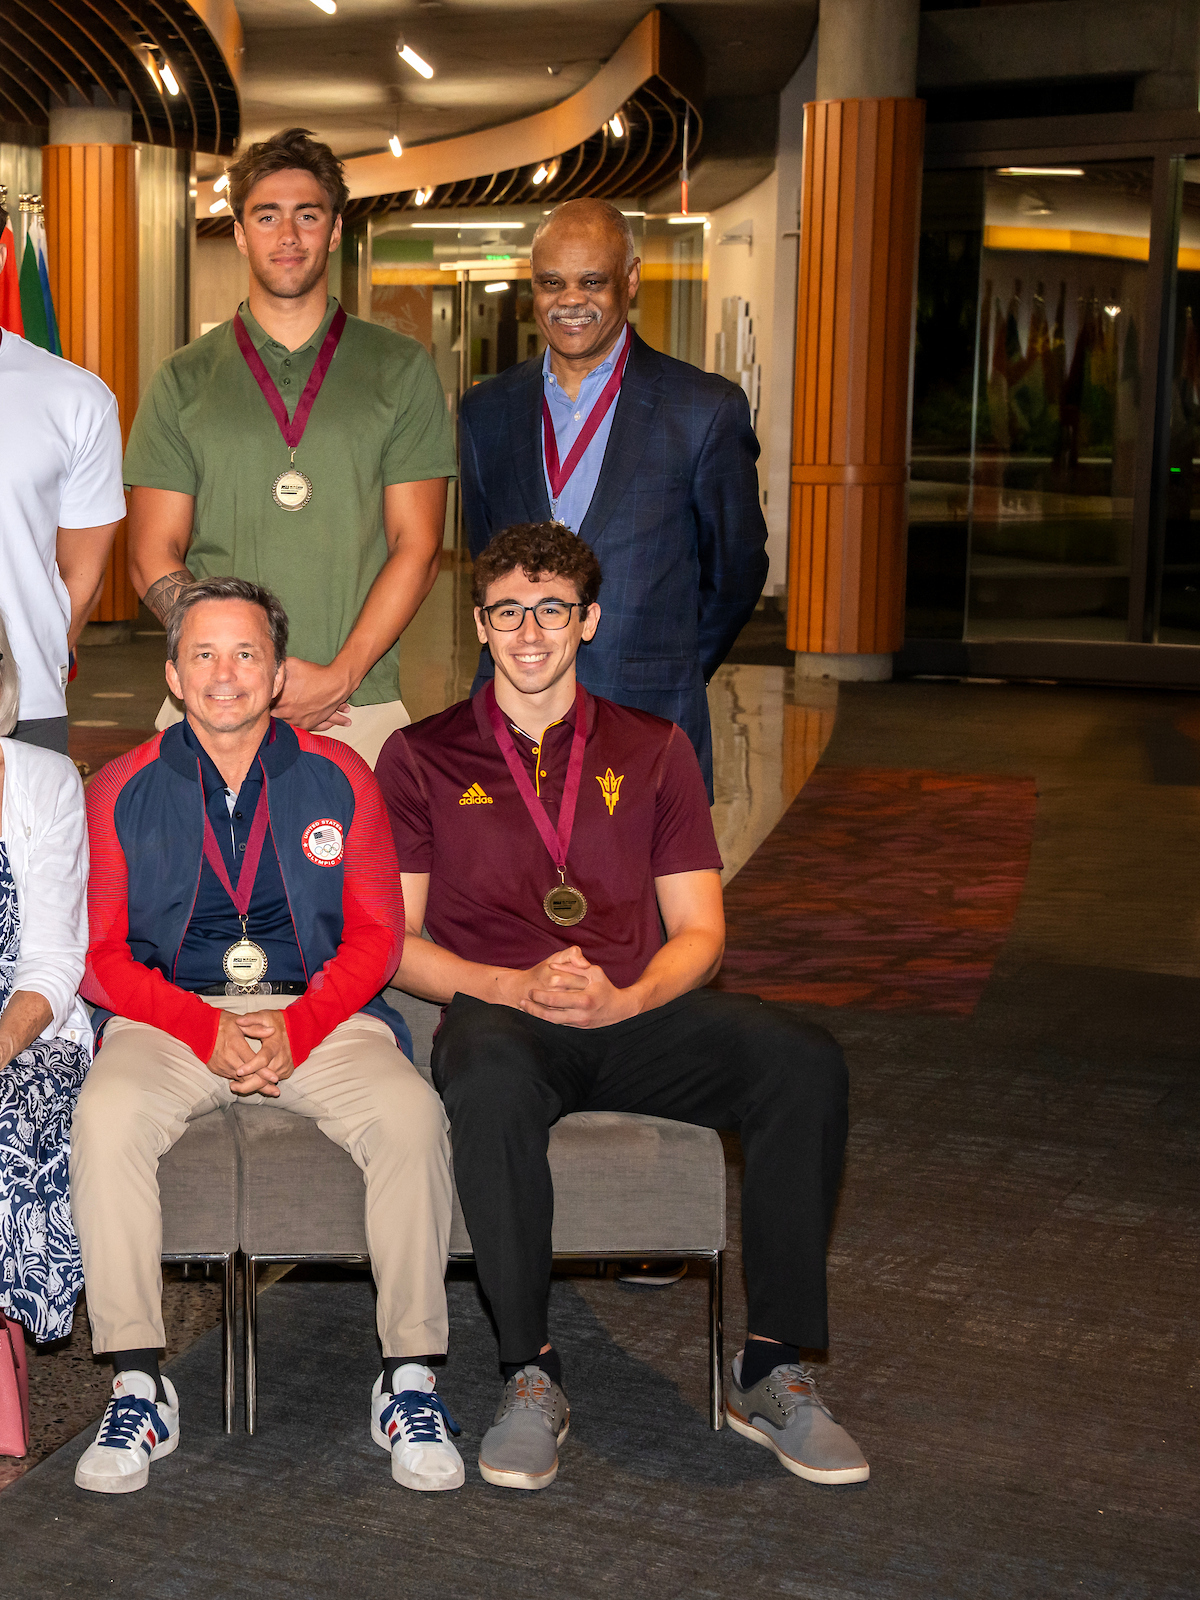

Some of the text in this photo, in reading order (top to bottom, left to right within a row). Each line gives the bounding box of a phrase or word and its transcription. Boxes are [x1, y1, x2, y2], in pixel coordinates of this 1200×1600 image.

[459, 796, 494, 805] adidas
[304, 820, 342, 839] UNITED STATES
[307, 852, 335, 865] OLYMPIC
